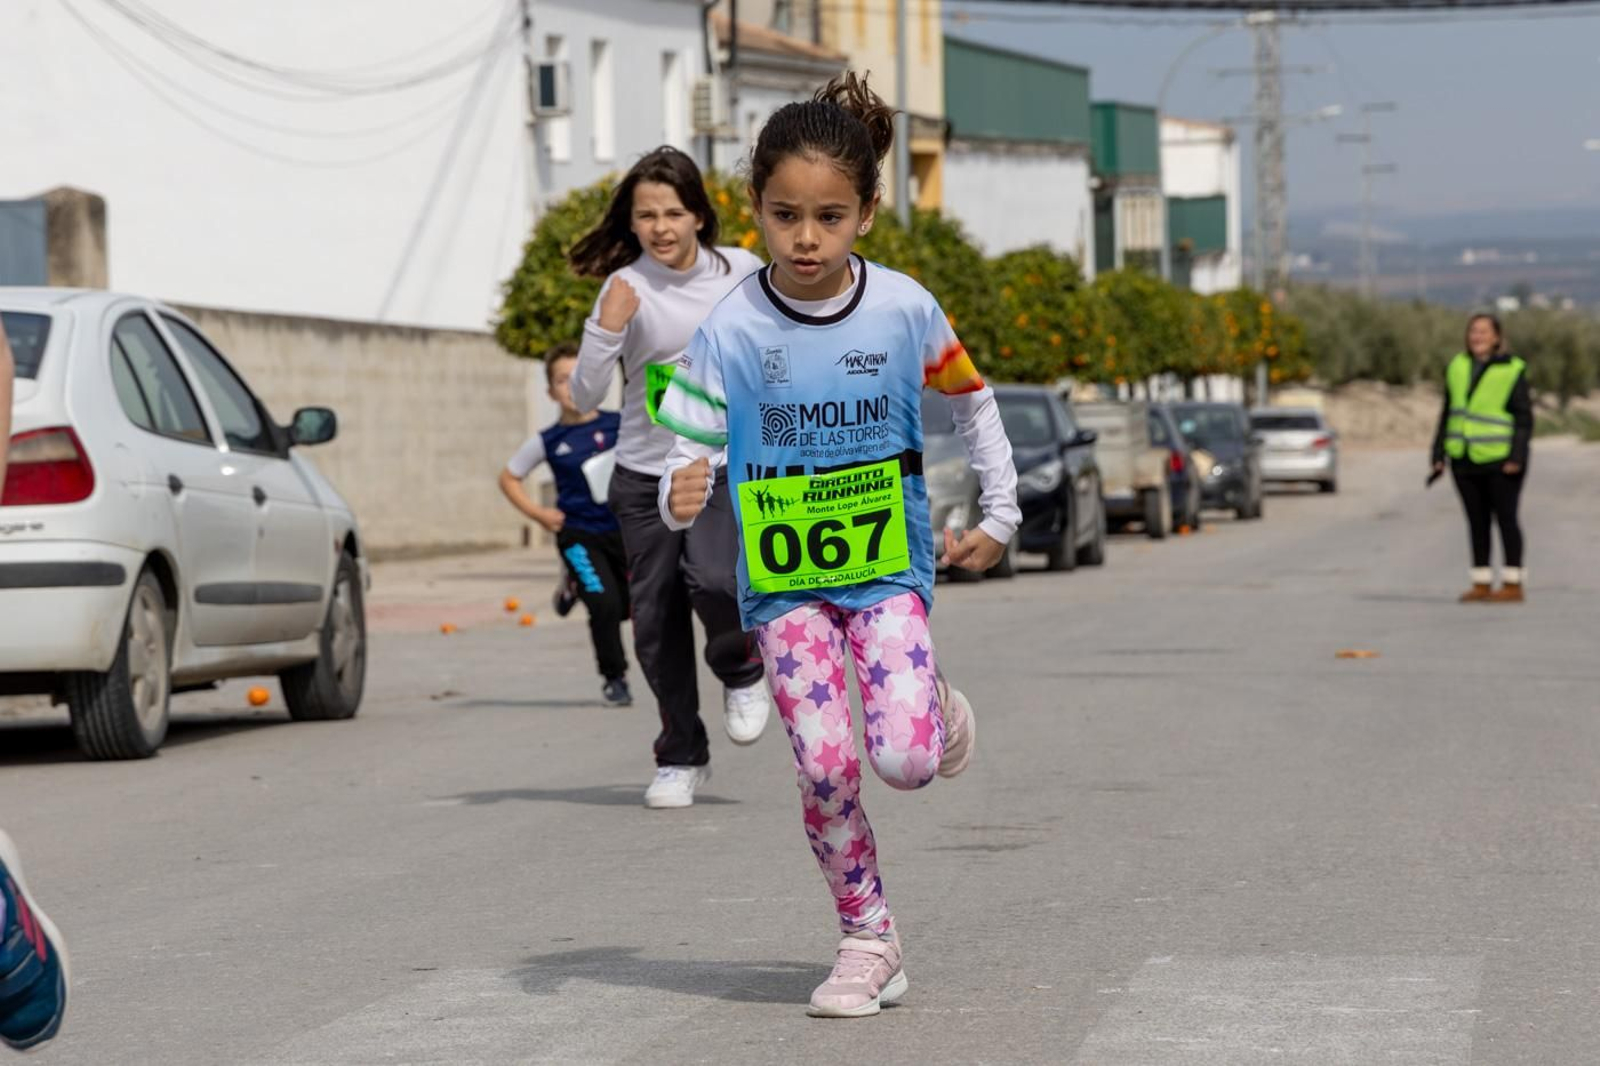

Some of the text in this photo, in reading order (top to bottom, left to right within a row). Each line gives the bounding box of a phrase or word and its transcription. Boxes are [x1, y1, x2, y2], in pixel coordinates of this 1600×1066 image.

[845, 351, 888, 369] MARATHON
[799, 394, 889, 430] MOLINO
[800, 422, 889, 447] DE LAS TORRES
[825, 448, 834, 458] de
[835, 446, 854, 457] oliva
[855, 443, 878, 455] virgen
[802, 475, 894, 503] RUNNING
[809, 467, 884, 489] CIRCUITO
[806, 493, 892, 514] Monte Lope Álvarez
[759, 507, 893, 575] 067
[789, 567, 877, 587] DÍA DE ANDALUCÍA
